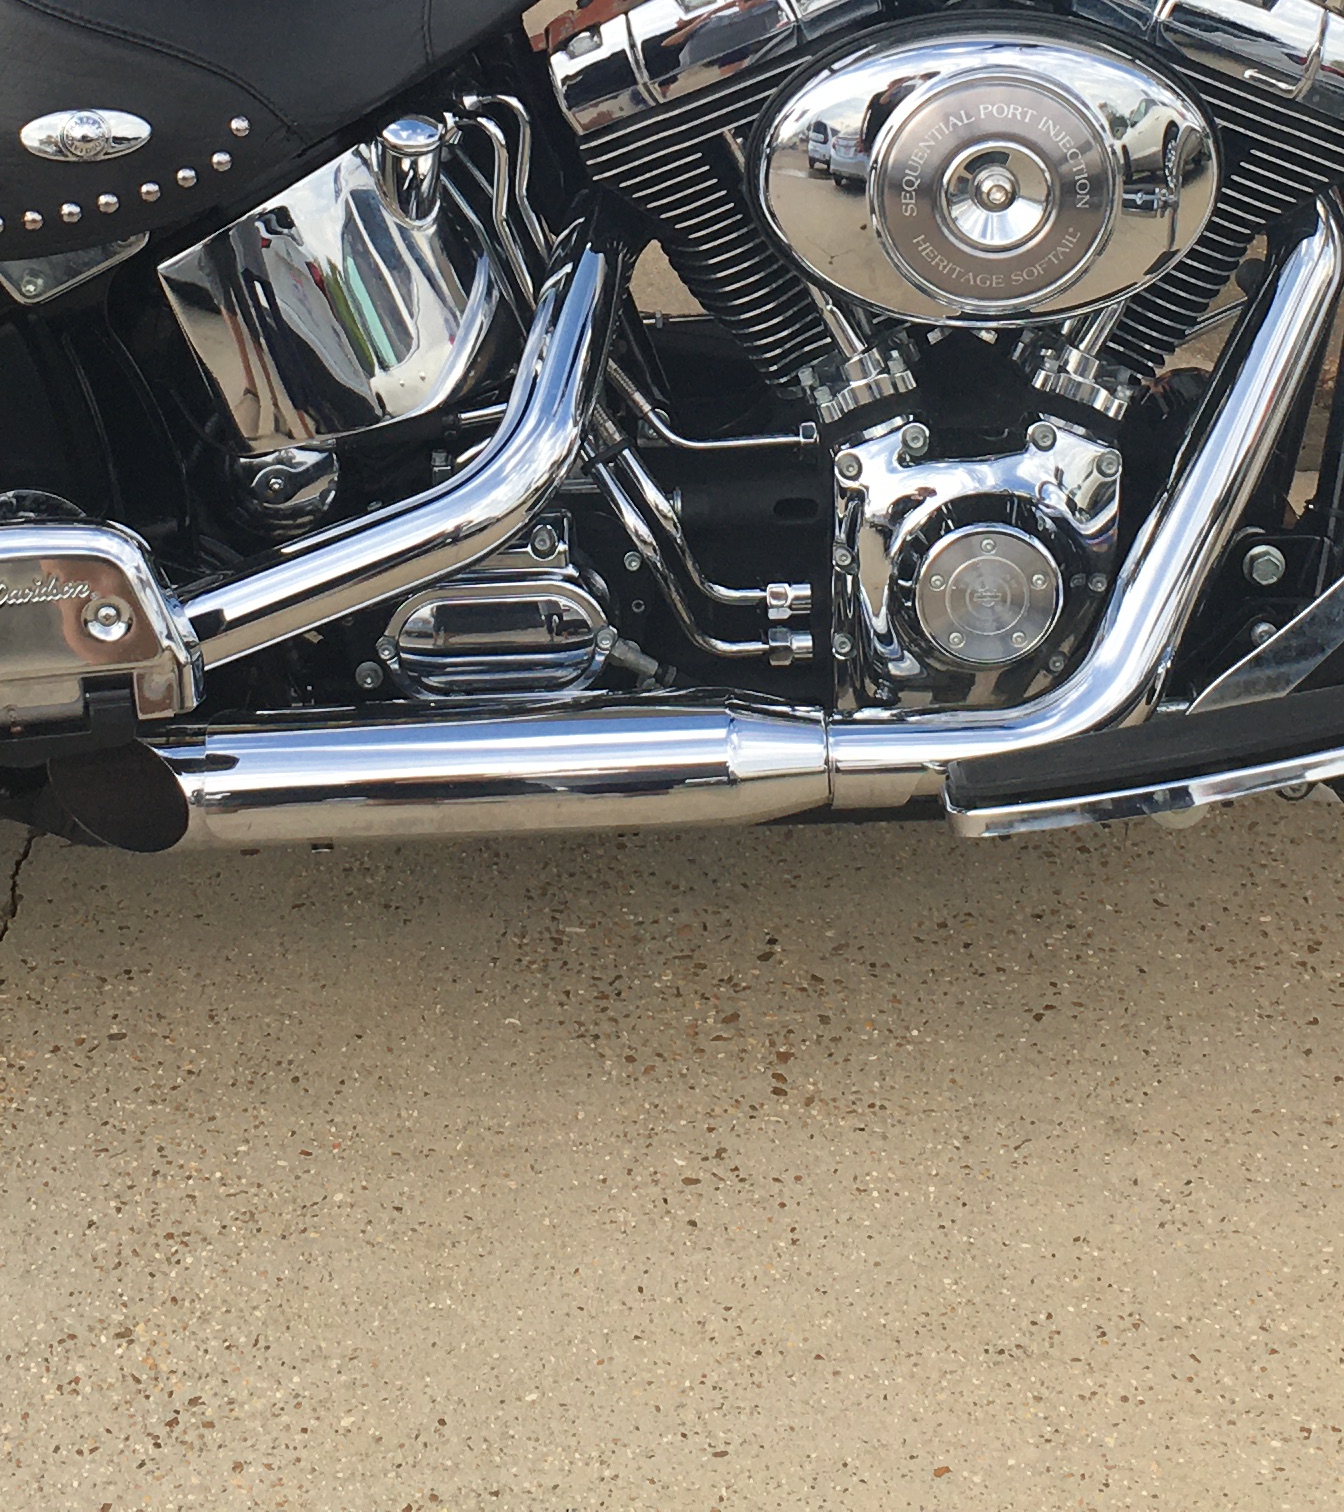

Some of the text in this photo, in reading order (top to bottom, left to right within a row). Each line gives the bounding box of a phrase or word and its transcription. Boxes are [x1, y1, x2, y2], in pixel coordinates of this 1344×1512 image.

[901, 102, 1091, 217] SEQUENTIAL PORT INJECTION
[912, 229, 1081, 288] HERITAGE SOFTAIL
